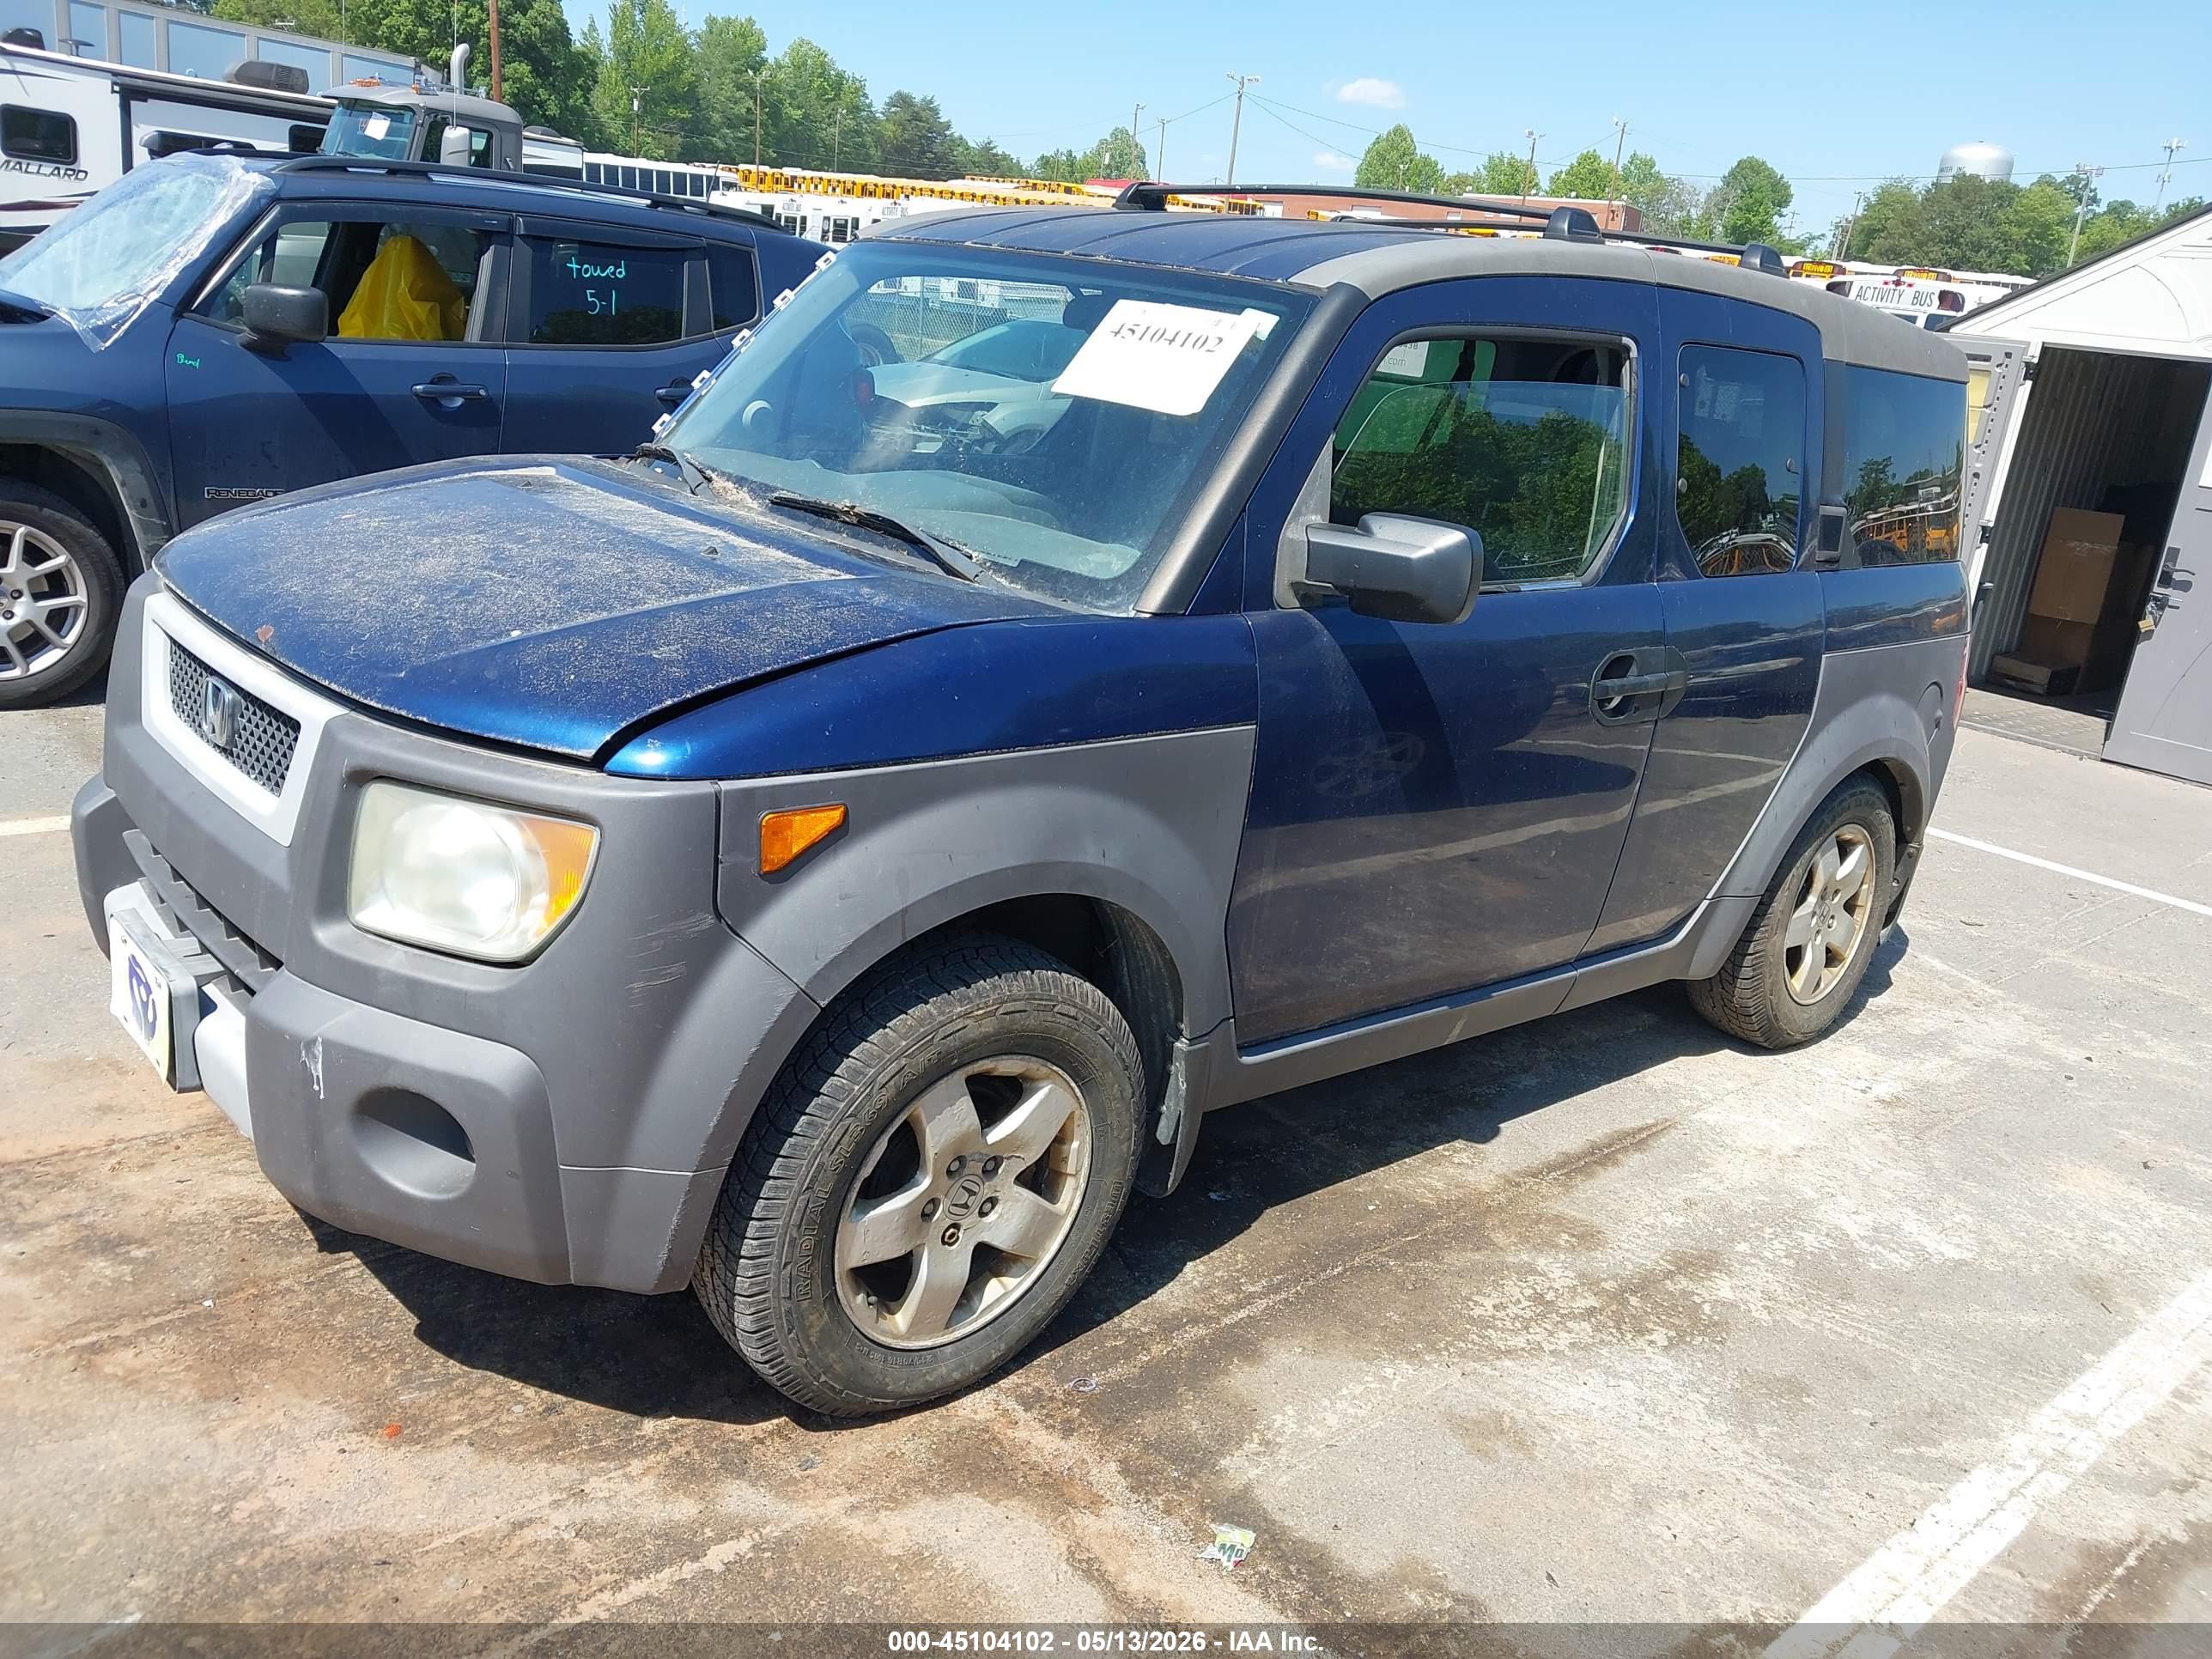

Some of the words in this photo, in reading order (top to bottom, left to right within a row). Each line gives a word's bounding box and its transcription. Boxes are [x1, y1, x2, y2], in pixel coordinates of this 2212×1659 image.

[0, 159, 88, 181] MALLARD
[566, 256, 626, 279] towed
[586, 289, 616, 315] 5-1
[1855, 285, 1905, 305] ACTIVITY
[1911, 290, 1936, 307] BUS
[1109, 322, 1224, 353] 45104102
[793, 1182, 834, 1303] RADIAL
[829, 1090, 890, 1176] SL369
